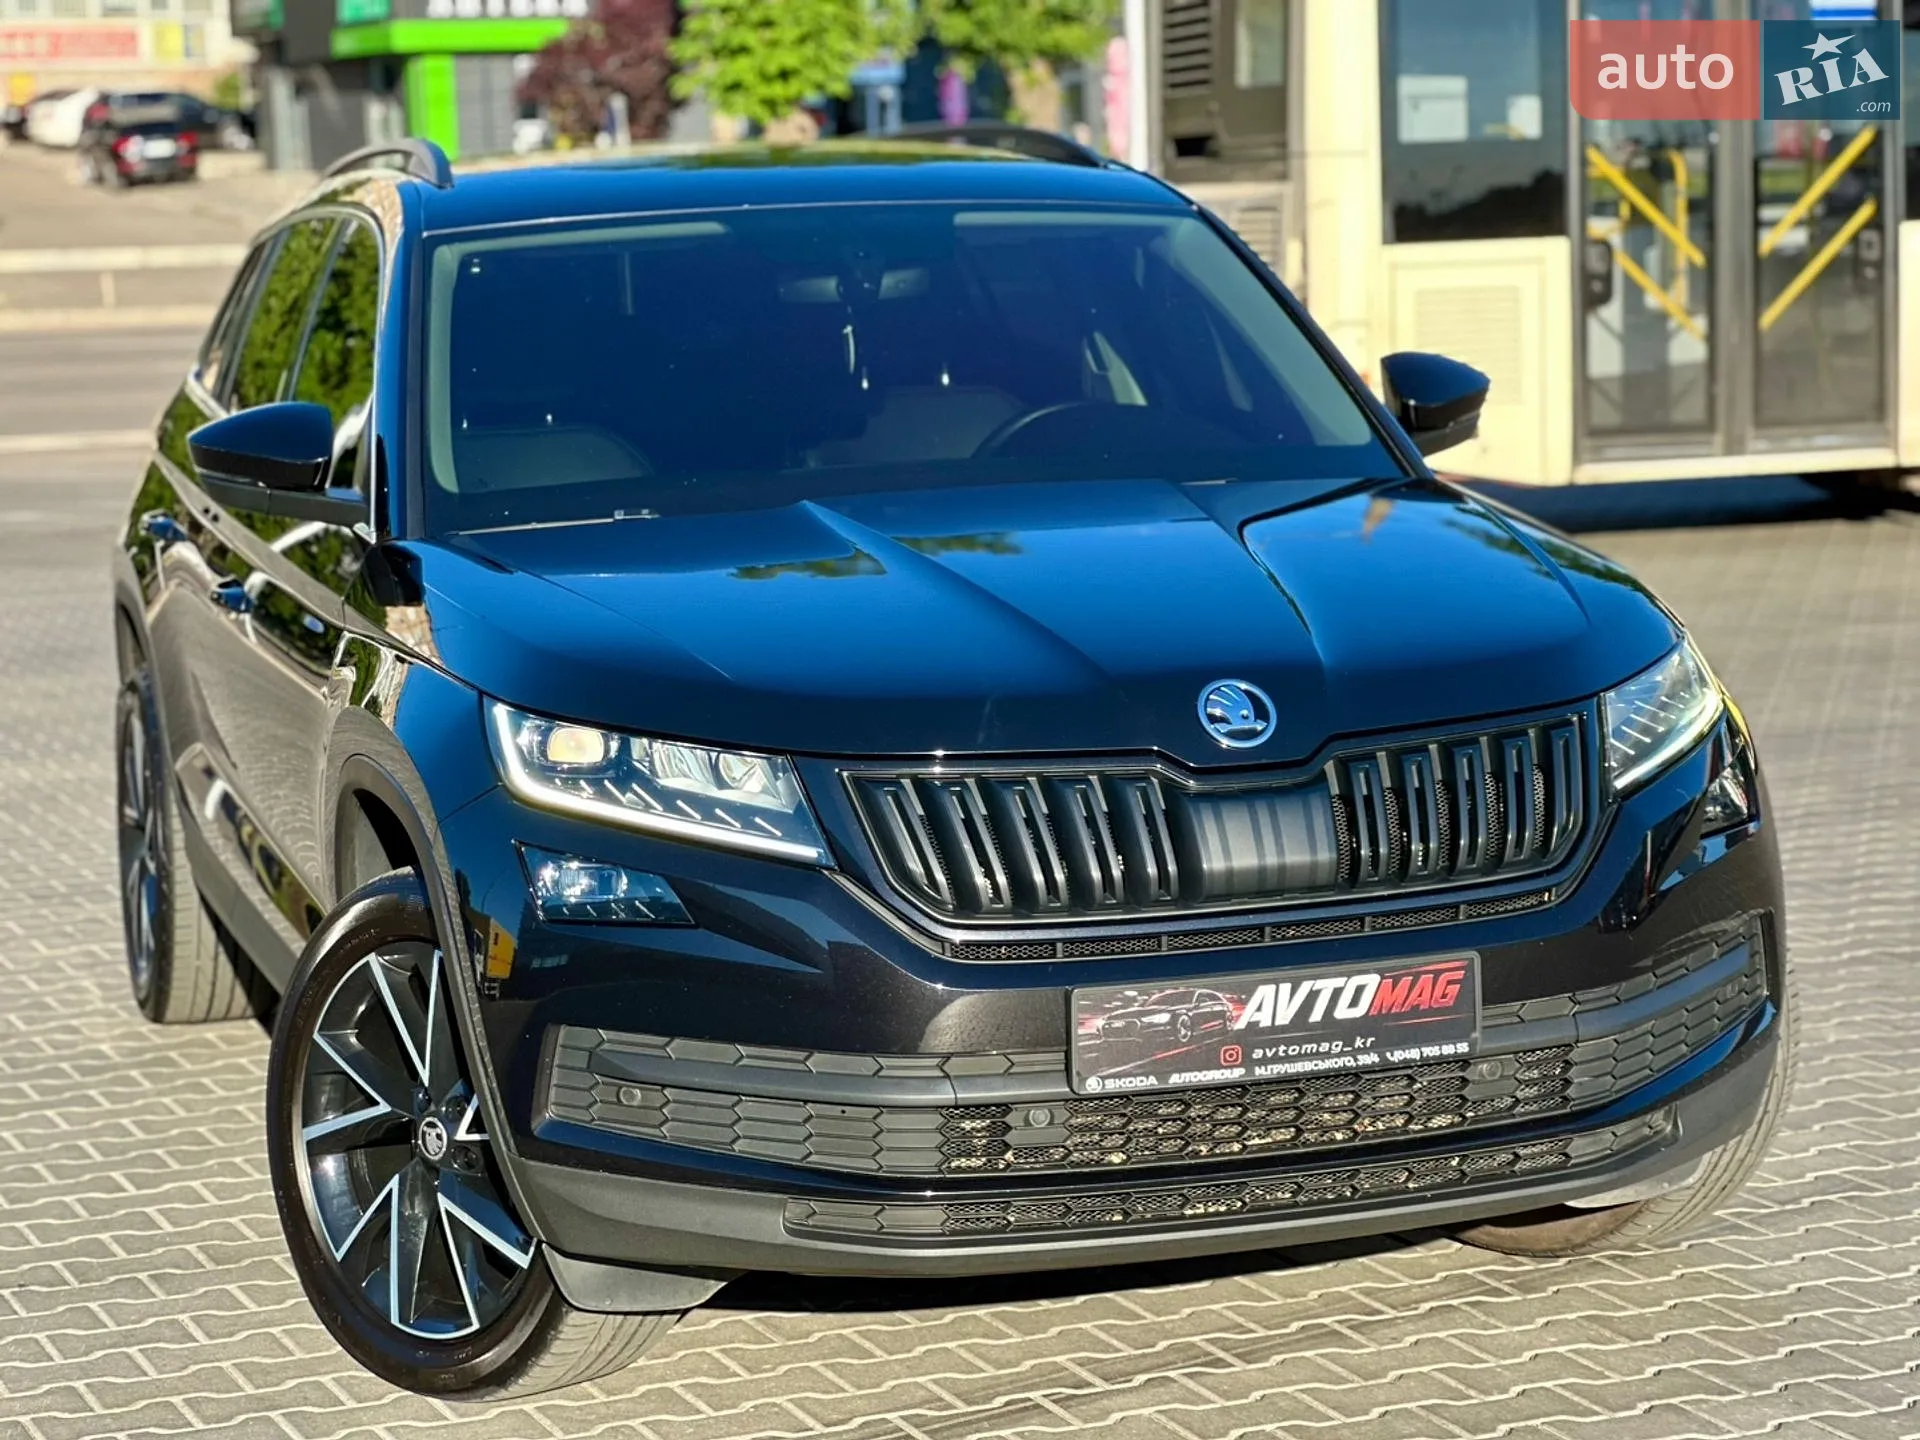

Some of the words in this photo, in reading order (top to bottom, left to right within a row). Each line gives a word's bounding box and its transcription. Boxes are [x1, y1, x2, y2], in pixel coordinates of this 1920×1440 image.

[1233, 970, 1466, 1030] AVTOMAG
[1252, 1036, 1376, 1059] avtomag_kr
[1104, 1075, 1159, 1089] SKODA
[1168, 1068, 1246, 1084] AUTOGROUP
